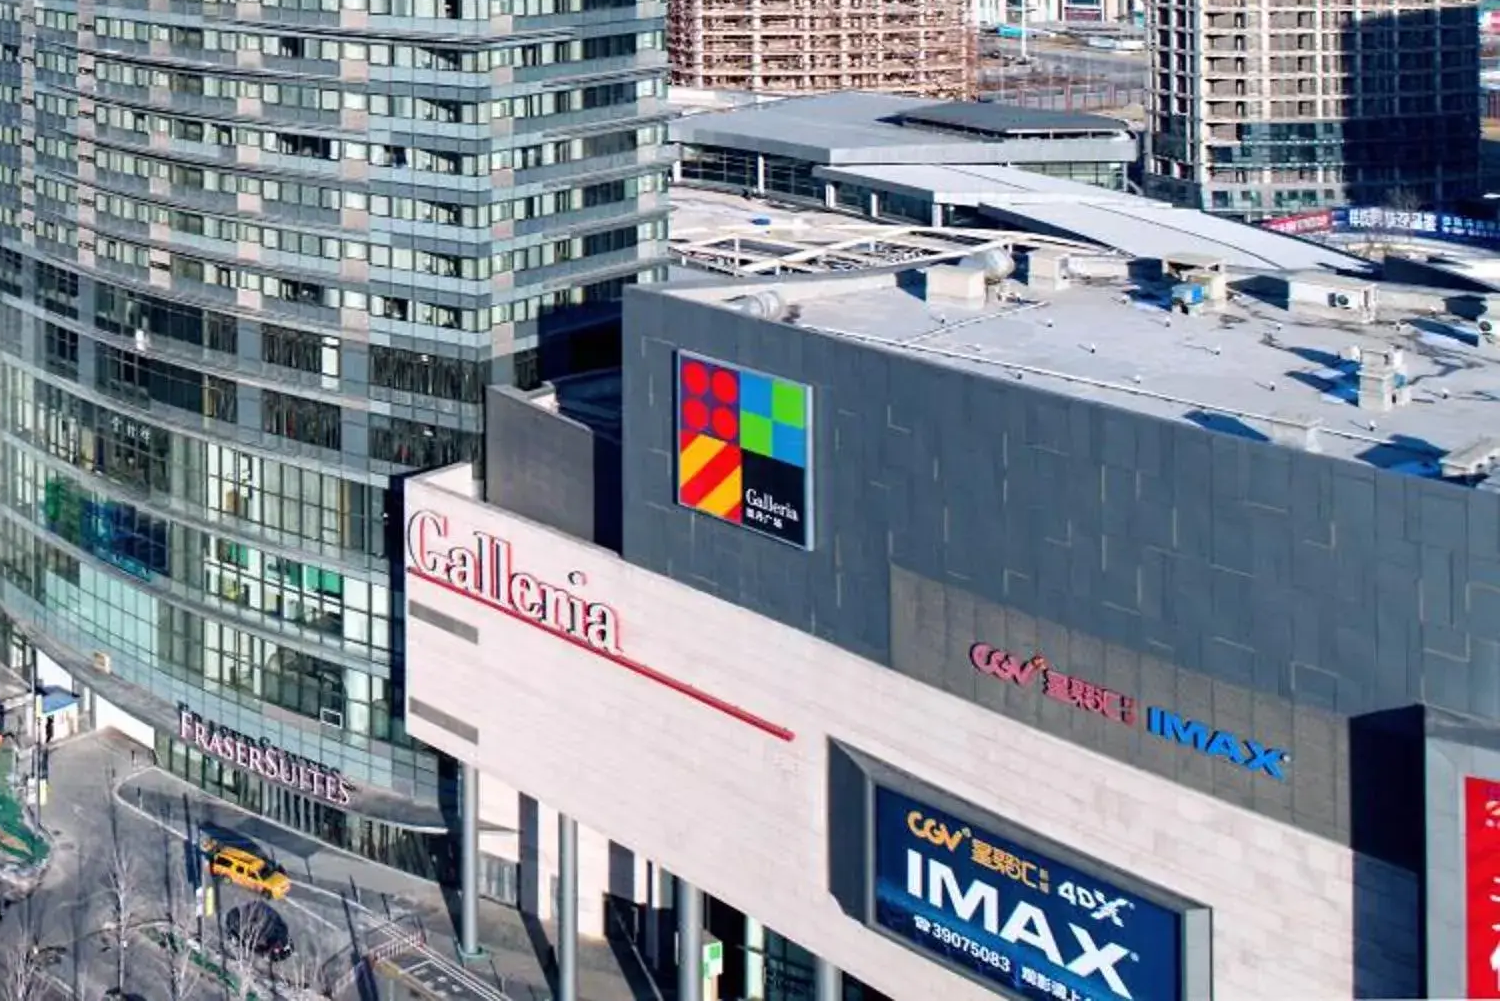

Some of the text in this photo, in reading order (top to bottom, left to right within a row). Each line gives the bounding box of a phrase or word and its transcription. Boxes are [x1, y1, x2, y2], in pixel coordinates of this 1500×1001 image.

[745, 488, 799, 522] Galleria
[406, 508, 622, 655] Galleria
[969, 641, 1034, 687] CGV
[1146, 705, 1286, 782] IMAX
[906, 847, 1134, 1000] IMAX
[907, 810, 964, 853] CGV
[1057, 880, 1131, 928] 4DX
[931, 925, 1011, 973] 39075083
